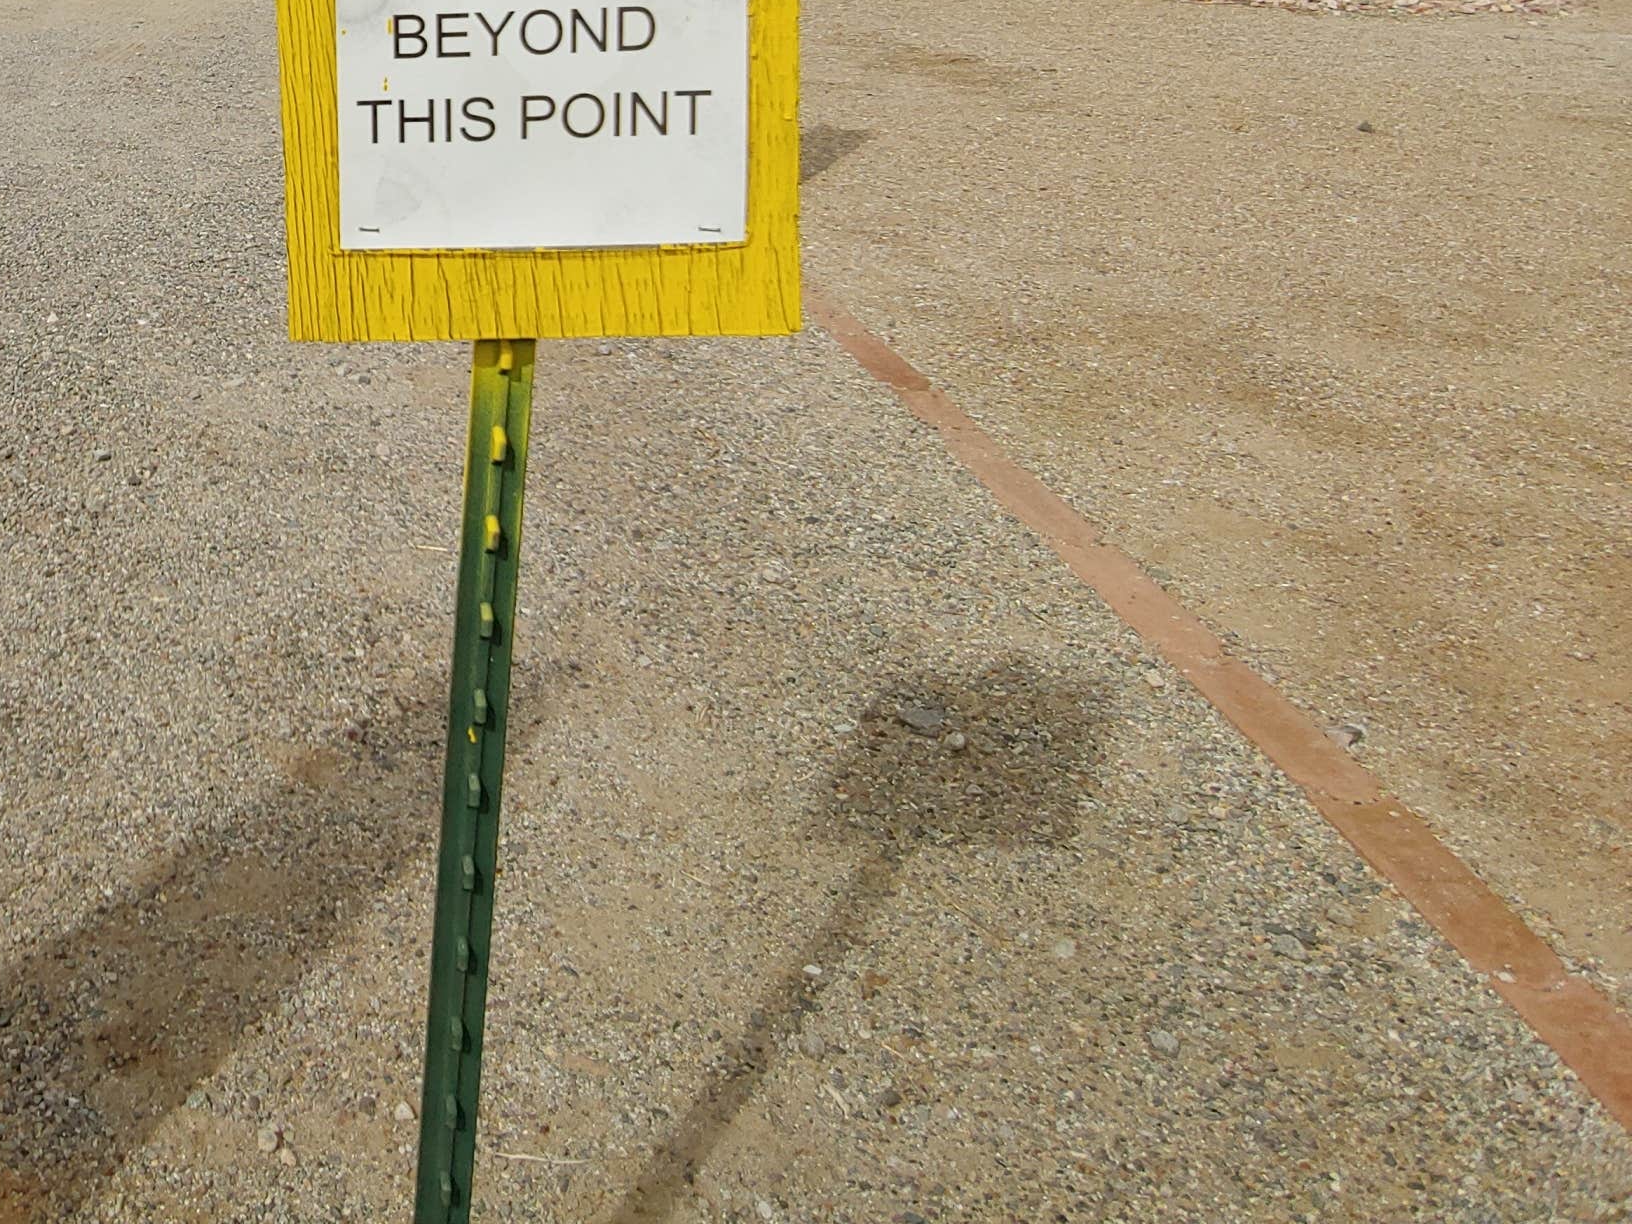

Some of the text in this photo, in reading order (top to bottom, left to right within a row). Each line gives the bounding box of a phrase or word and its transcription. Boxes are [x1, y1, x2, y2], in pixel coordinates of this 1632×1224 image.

[391, 5, 657, 60] BEYOND
[356, 89, 713, 144] THIS POINT
